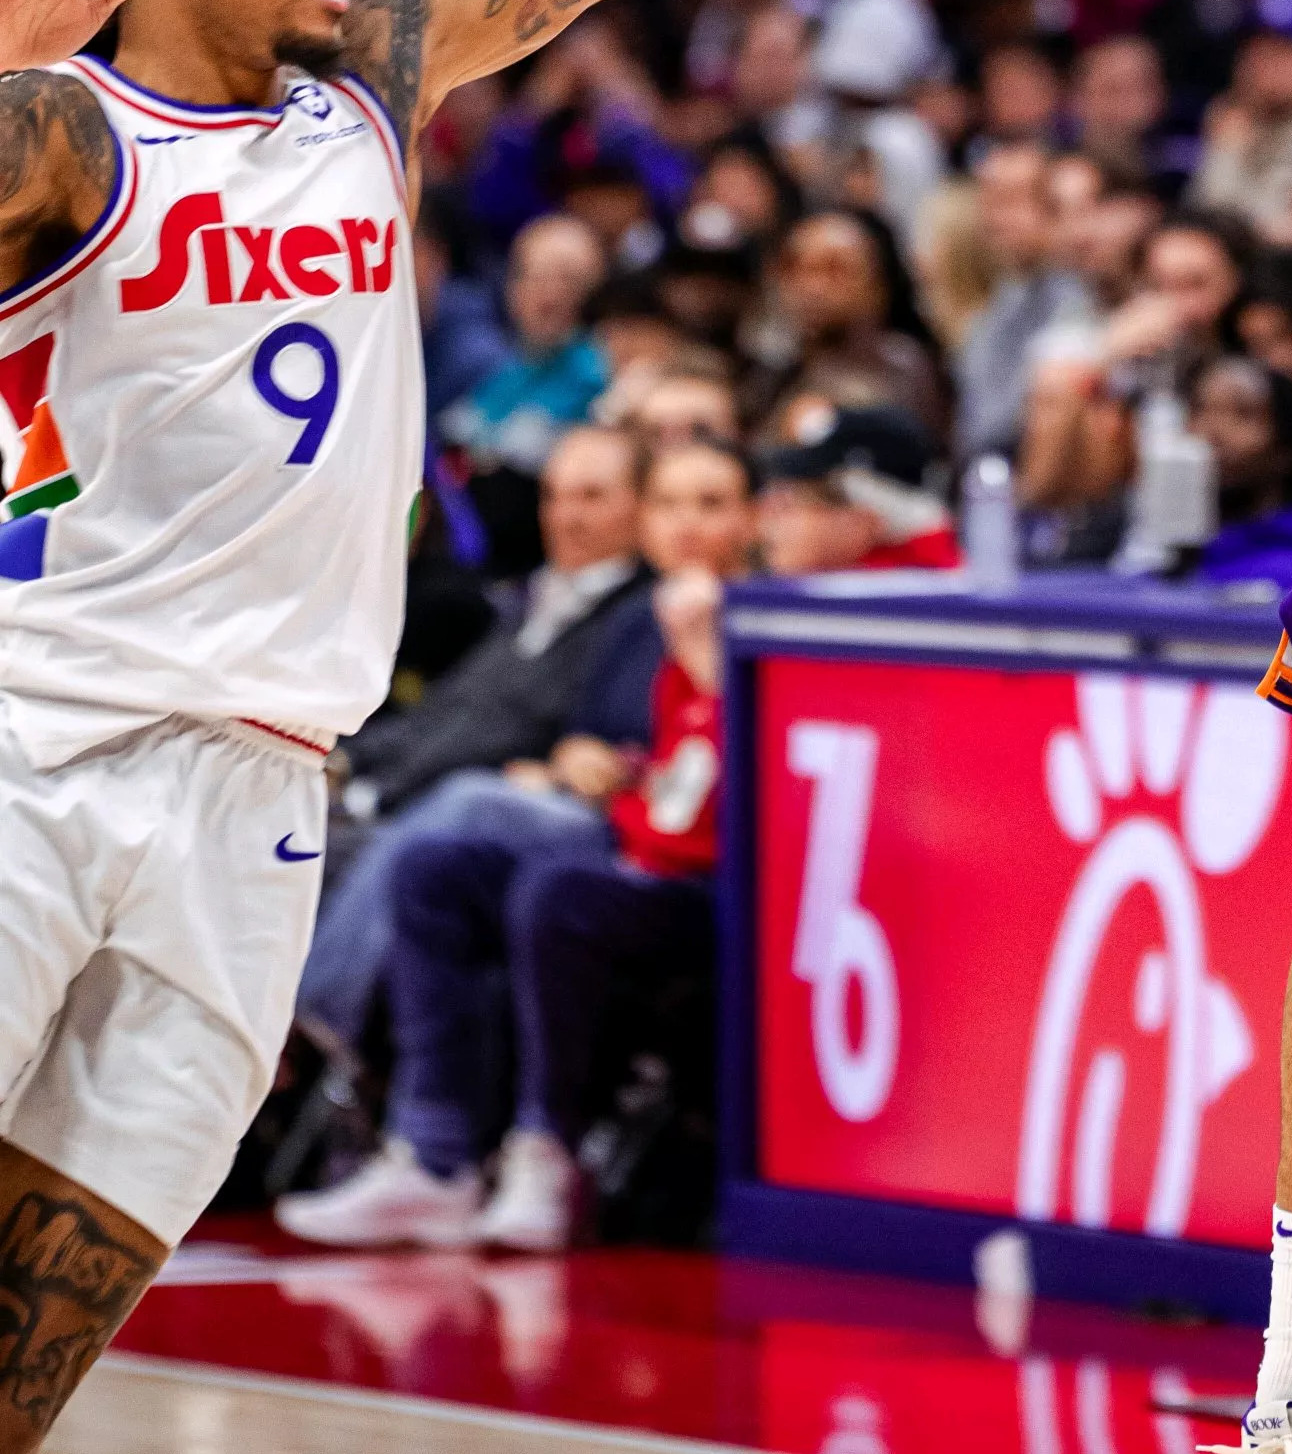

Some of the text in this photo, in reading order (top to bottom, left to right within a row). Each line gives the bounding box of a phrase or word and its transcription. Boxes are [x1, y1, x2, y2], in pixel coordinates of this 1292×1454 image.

[119, 191, 397, 314] Sixers
[252, 322, 339, 465] 9
[1250, 1417, 1281, 1432] BOOK
